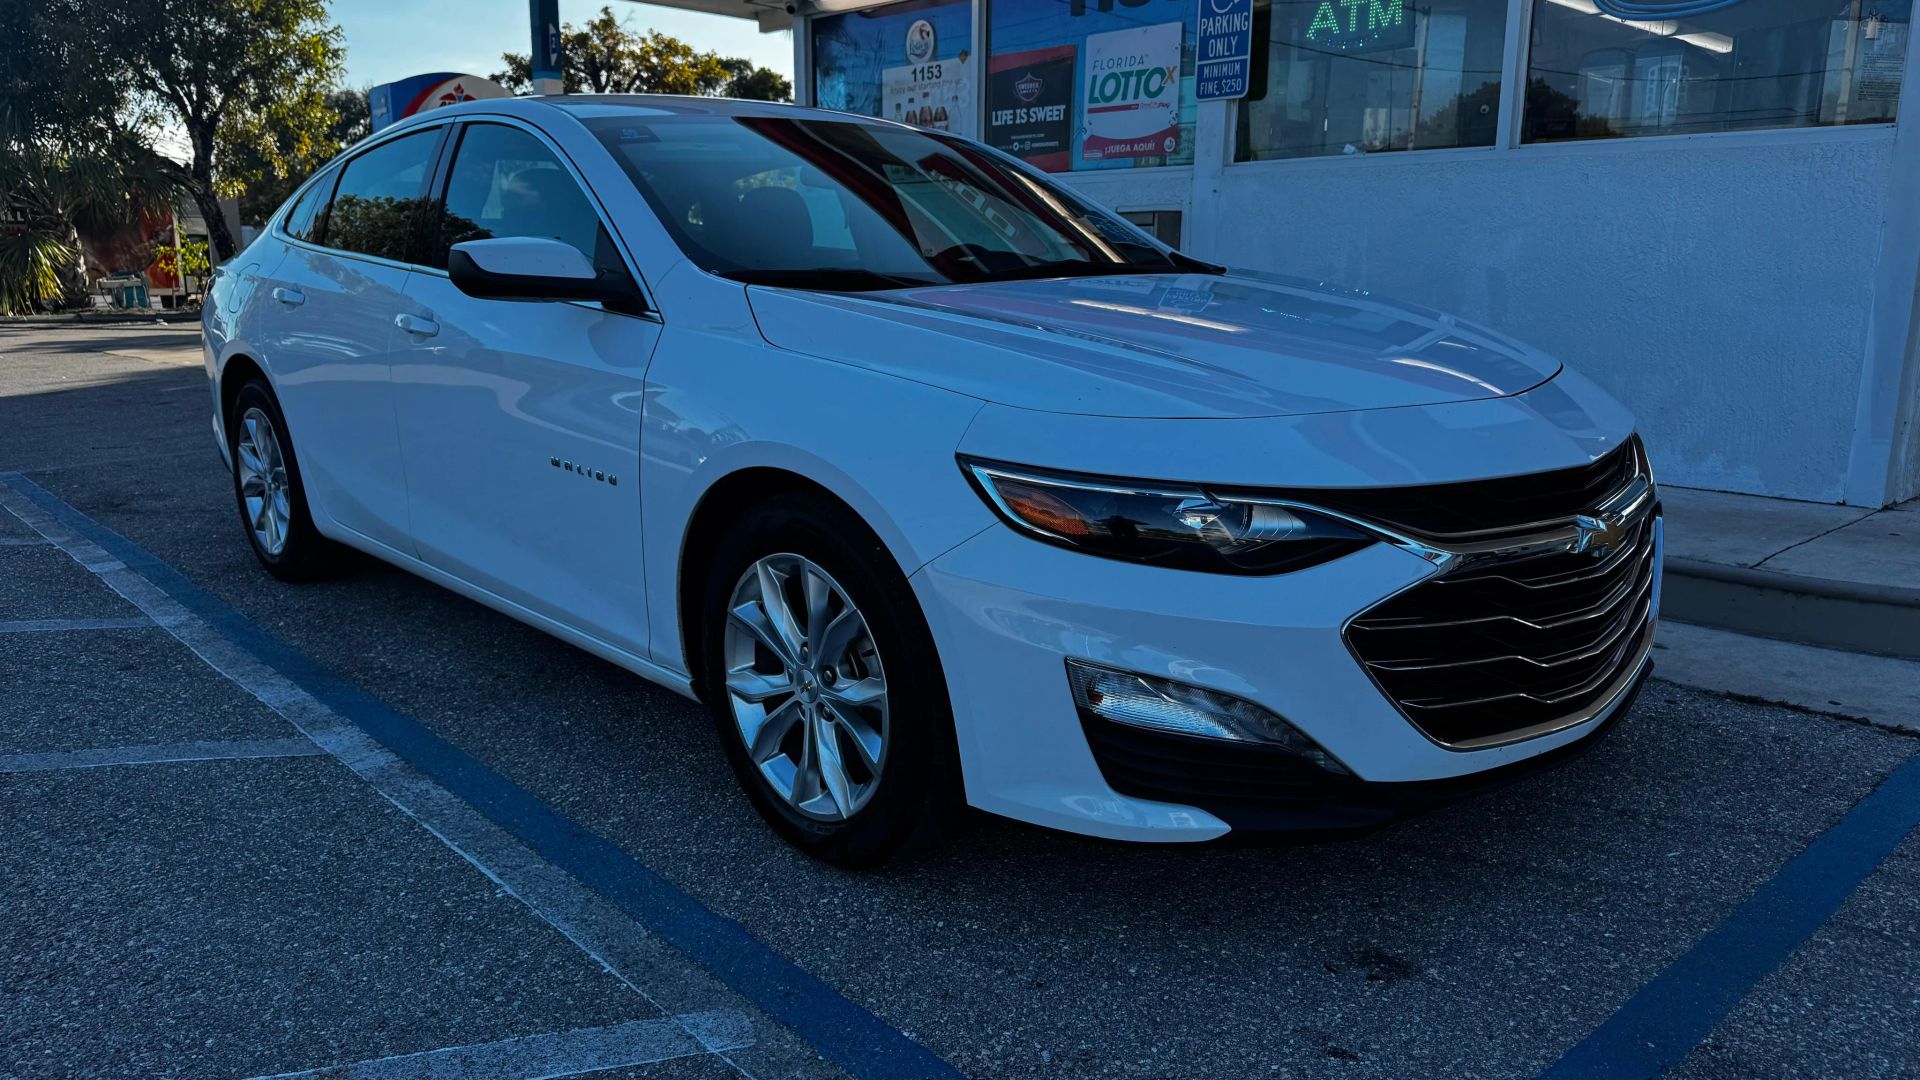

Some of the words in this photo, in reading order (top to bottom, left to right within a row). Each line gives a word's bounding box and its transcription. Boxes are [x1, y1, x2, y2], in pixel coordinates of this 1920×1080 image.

[1200, 12, 1249, 37] PARKING
[1306, 0, 1403, 39] ATM
[1208, 35, 1239, 58] ONLY
[911, 64, 942, 82] 1153
[1092, 55, 1145, 72] FLORIDA
[1203, 62, 1241, 79] MINIMUM
[1199, 80, 1219, 96] FINE
[1221, 78, 1242, 95] $250
[992, 109, 1014, 126] LIFE
[1015, 108, 1027, 124] IS
[1029, 104, 1066, 123] SWEET
